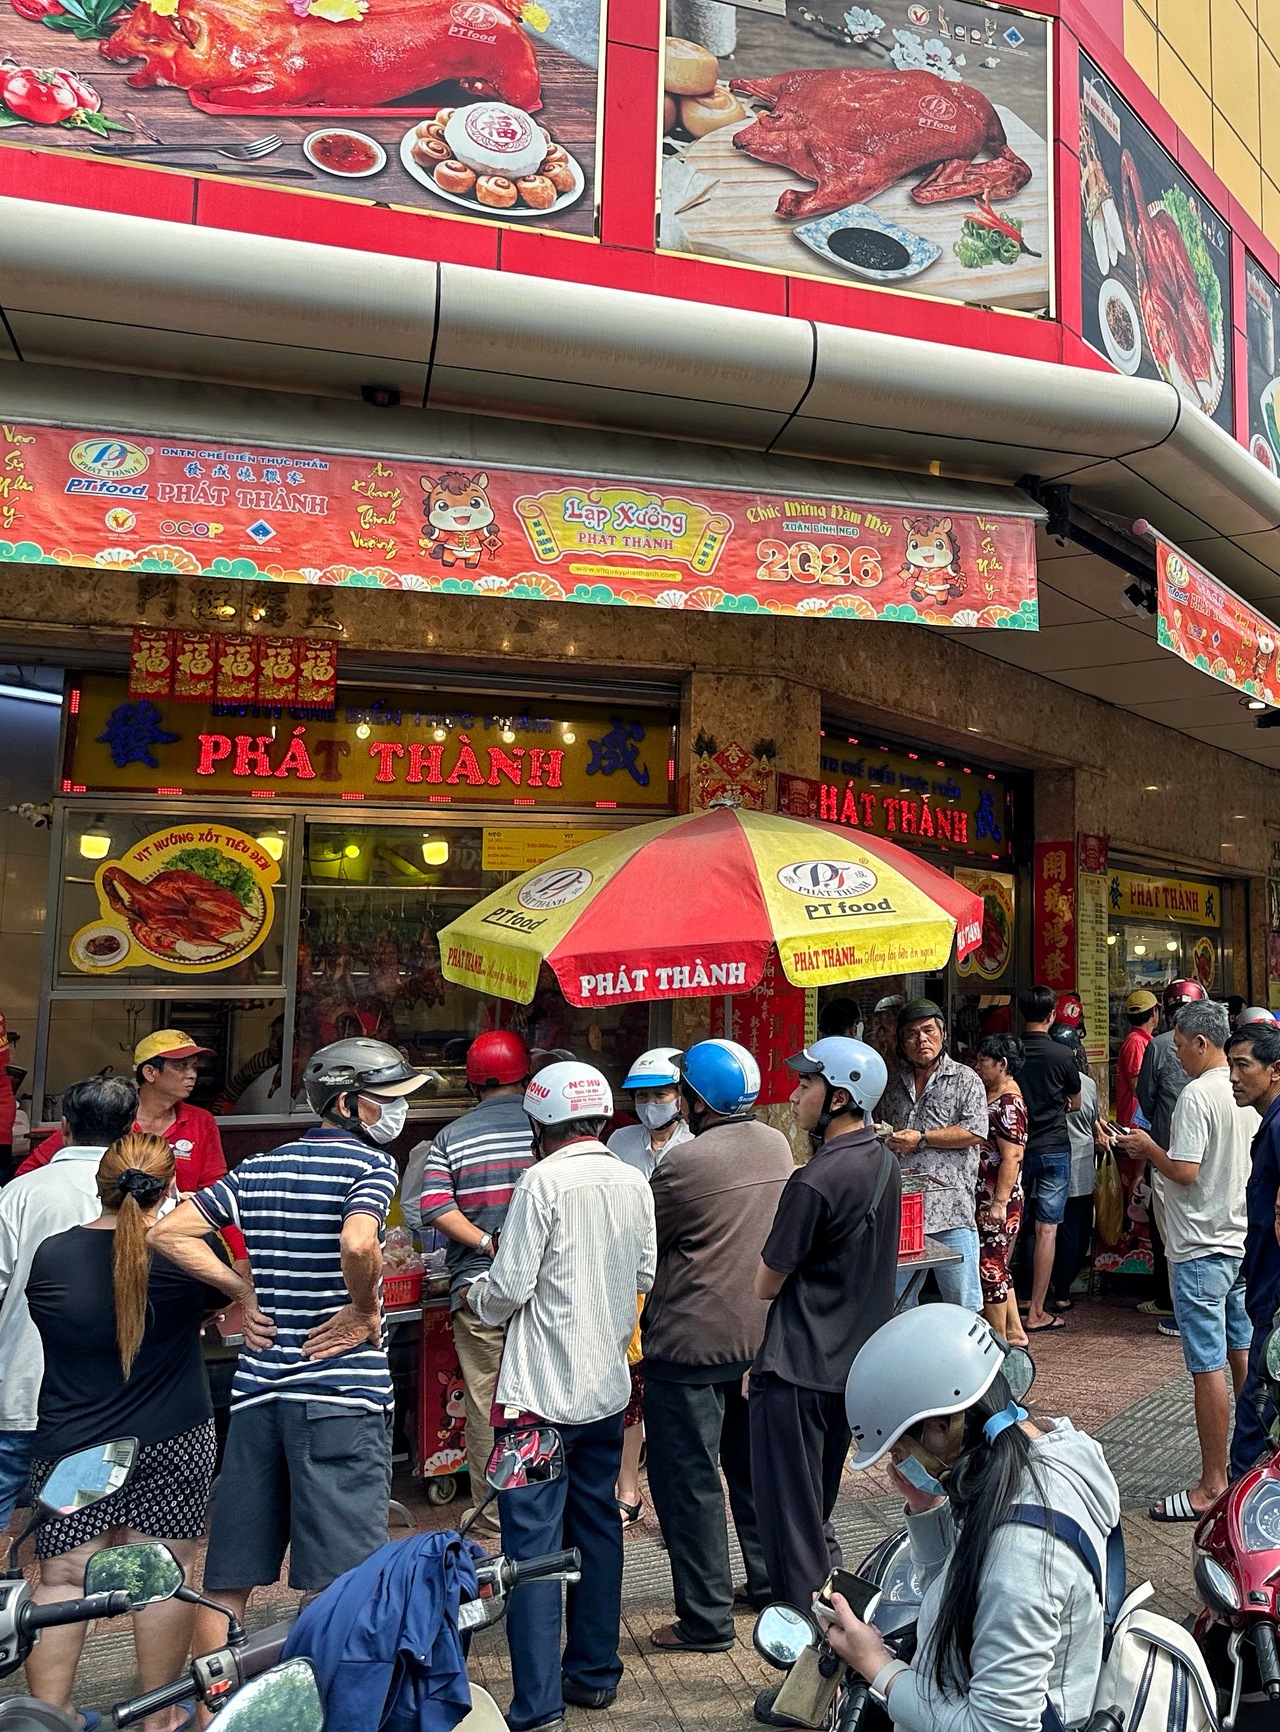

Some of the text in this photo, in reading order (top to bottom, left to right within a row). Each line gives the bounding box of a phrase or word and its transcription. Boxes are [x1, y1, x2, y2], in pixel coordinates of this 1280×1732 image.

[480, 115, 518, 140] 福
[79, 461, 139, 476] PHÁT THÀNH
[161, 448, 329, 470] DNTN CHẾ BIẾN THỰC PHẨM
[157, 480, 328, 516] PHÁT THÀNH
[160, 520, 224, 539] OCOP
[564, 497, 687, 537] Lạp Xưởng
[746, 501, 894, 537] Chúc Mừng Năm Mới
[783, 522, 811, 532] XUÂN
[578, 532, 674, 550] PHÁT THÀNH
[757, 538, 883, 588] 2026
[196, 726, 564, 788] PHÁT THÀNH
[820, 781, 968, 844] HÁT THÀNH
[133, 828, 271, 870] VỊT NƯỚNG XỐT TIÊU ĐEN
[798, 881, 871, 897] PHÁT THÀNH
[1130, 878, 1198, 912] PHÁT THÀNH
[805, 898, 893, 918] PT food
[793, 946, 820, 972] PHÁT
[579, 964, 649, 999] PHÁT
[654, 958, 746, 994] THÀNH
